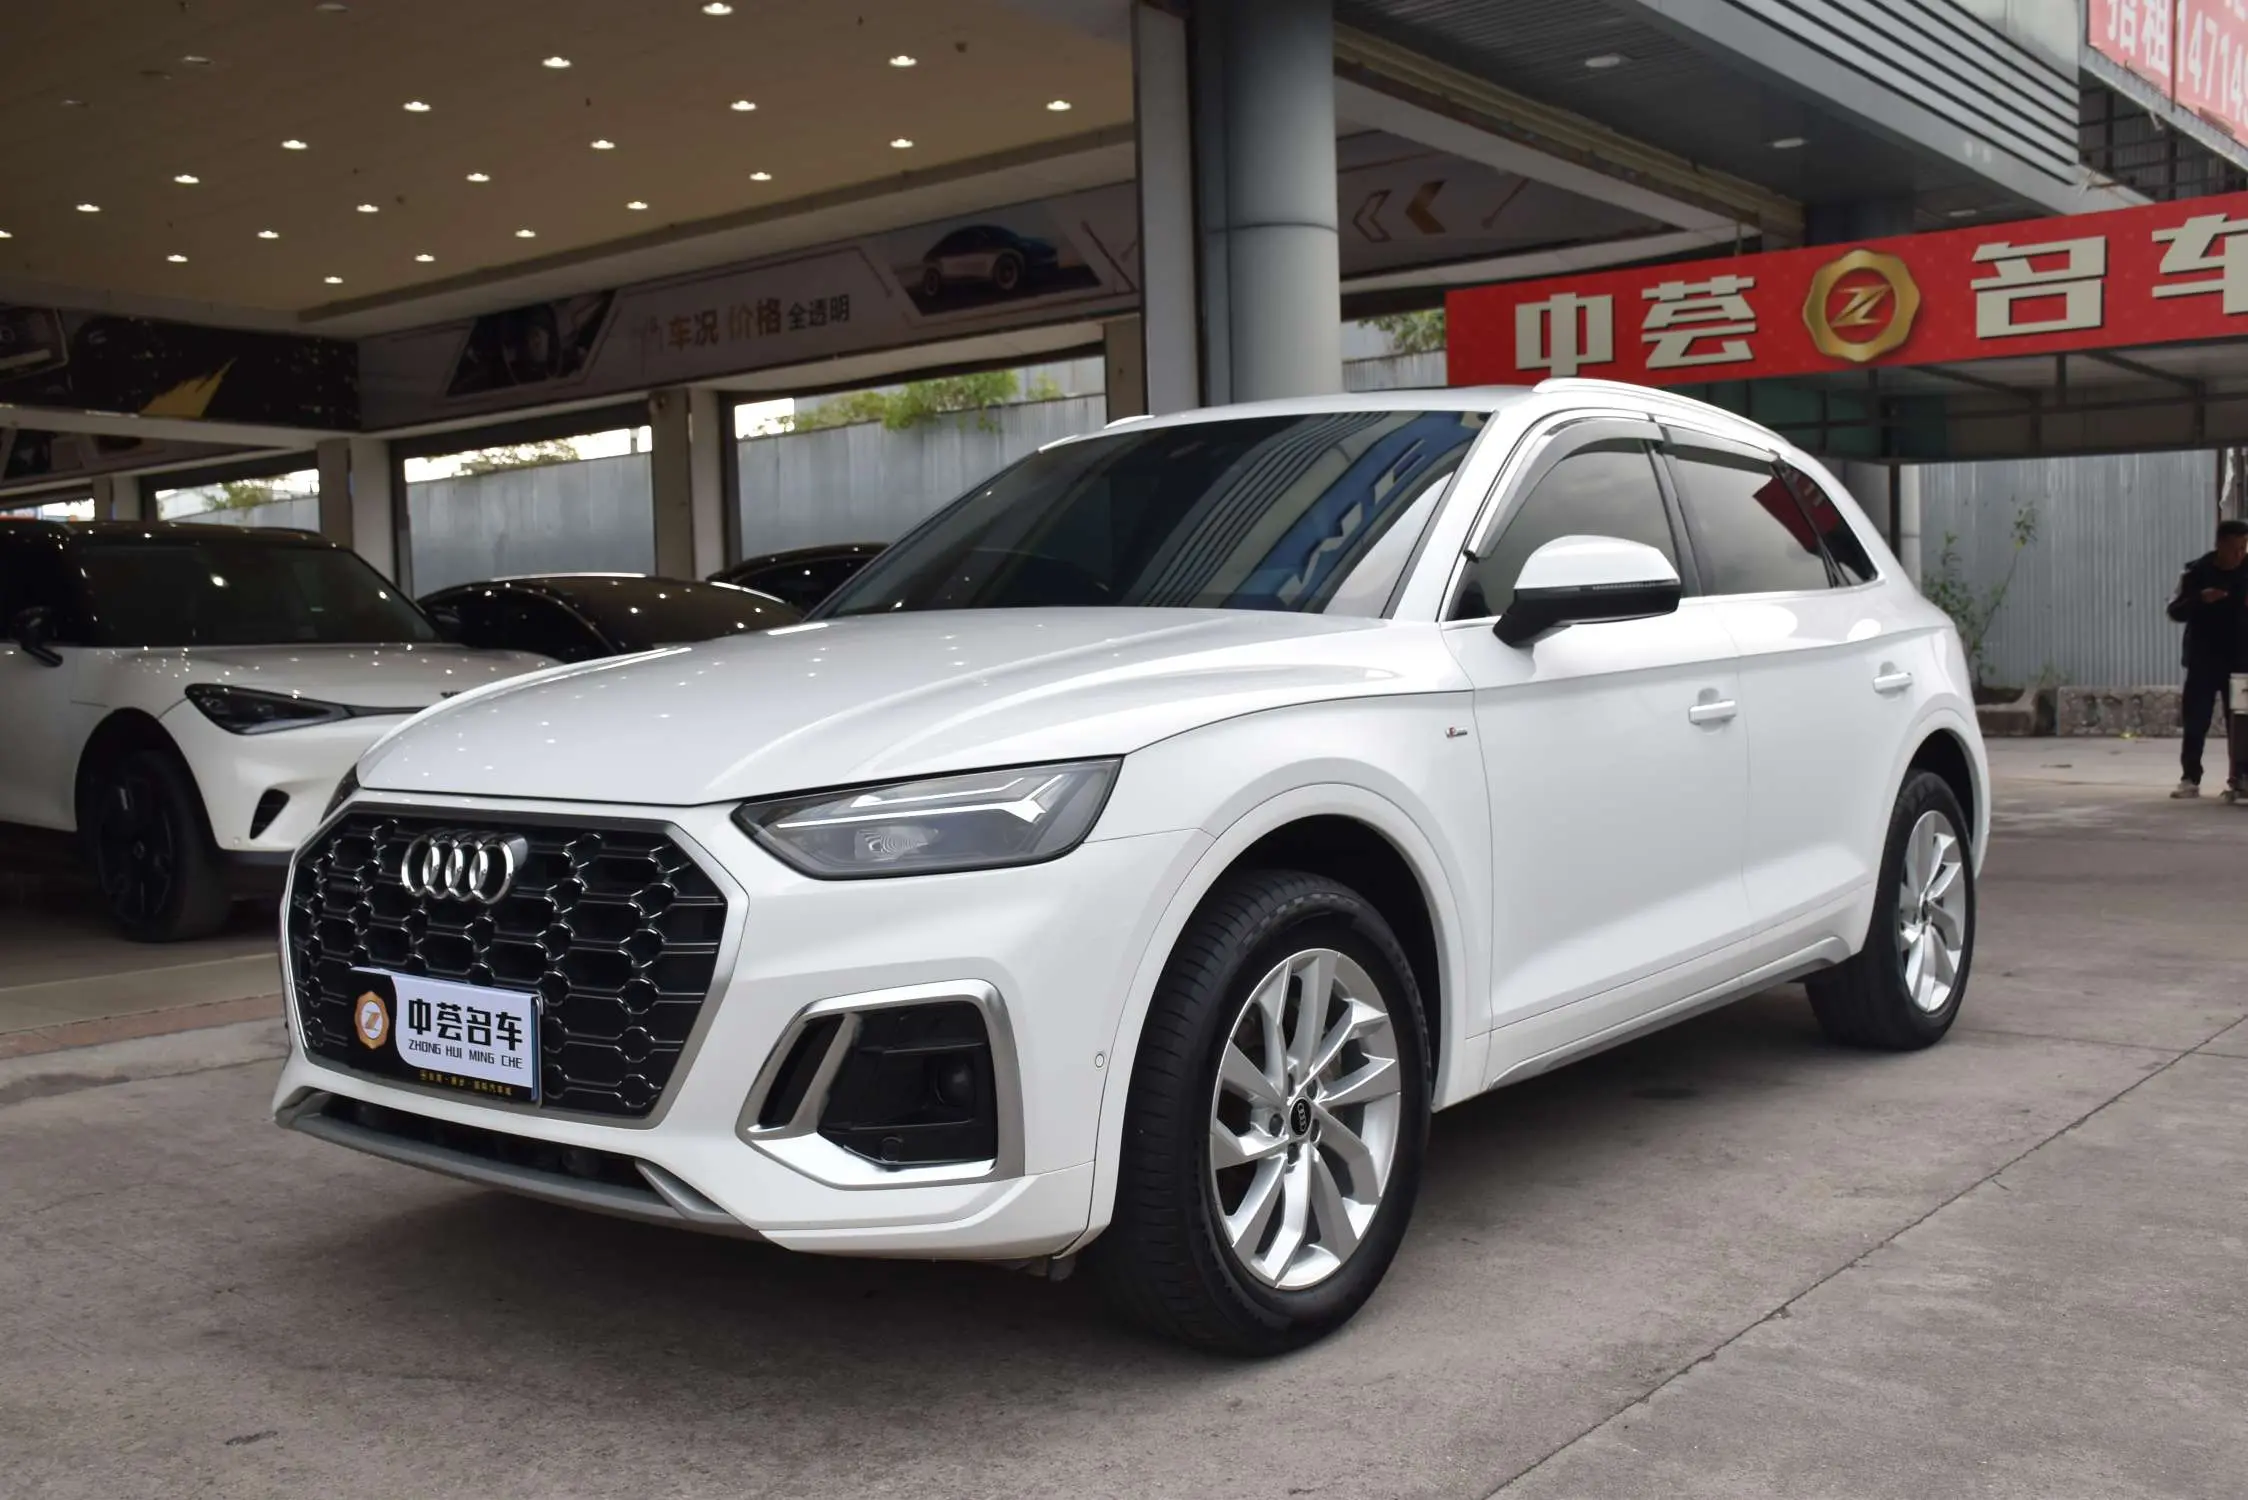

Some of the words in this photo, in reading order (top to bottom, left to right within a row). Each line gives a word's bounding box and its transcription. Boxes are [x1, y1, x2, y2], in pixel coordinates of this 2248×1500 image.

[1515, 275, 1756, 376] 中荟
[1971, 213, 2248, 338] 名车
[667, 308, 719, 352] 车况
[728, 298, 782, 342] 价格
[787, 294, 850, 331] 全透明
[408, 998, 523, 1051] 中荟名车
[409, 1039, 441, 1055] ZHONG
[446, 1045, 462, 1059] HUI
[469, 1049, 495, 1064] MING
[502, 1054, 523, 1069] CHE
